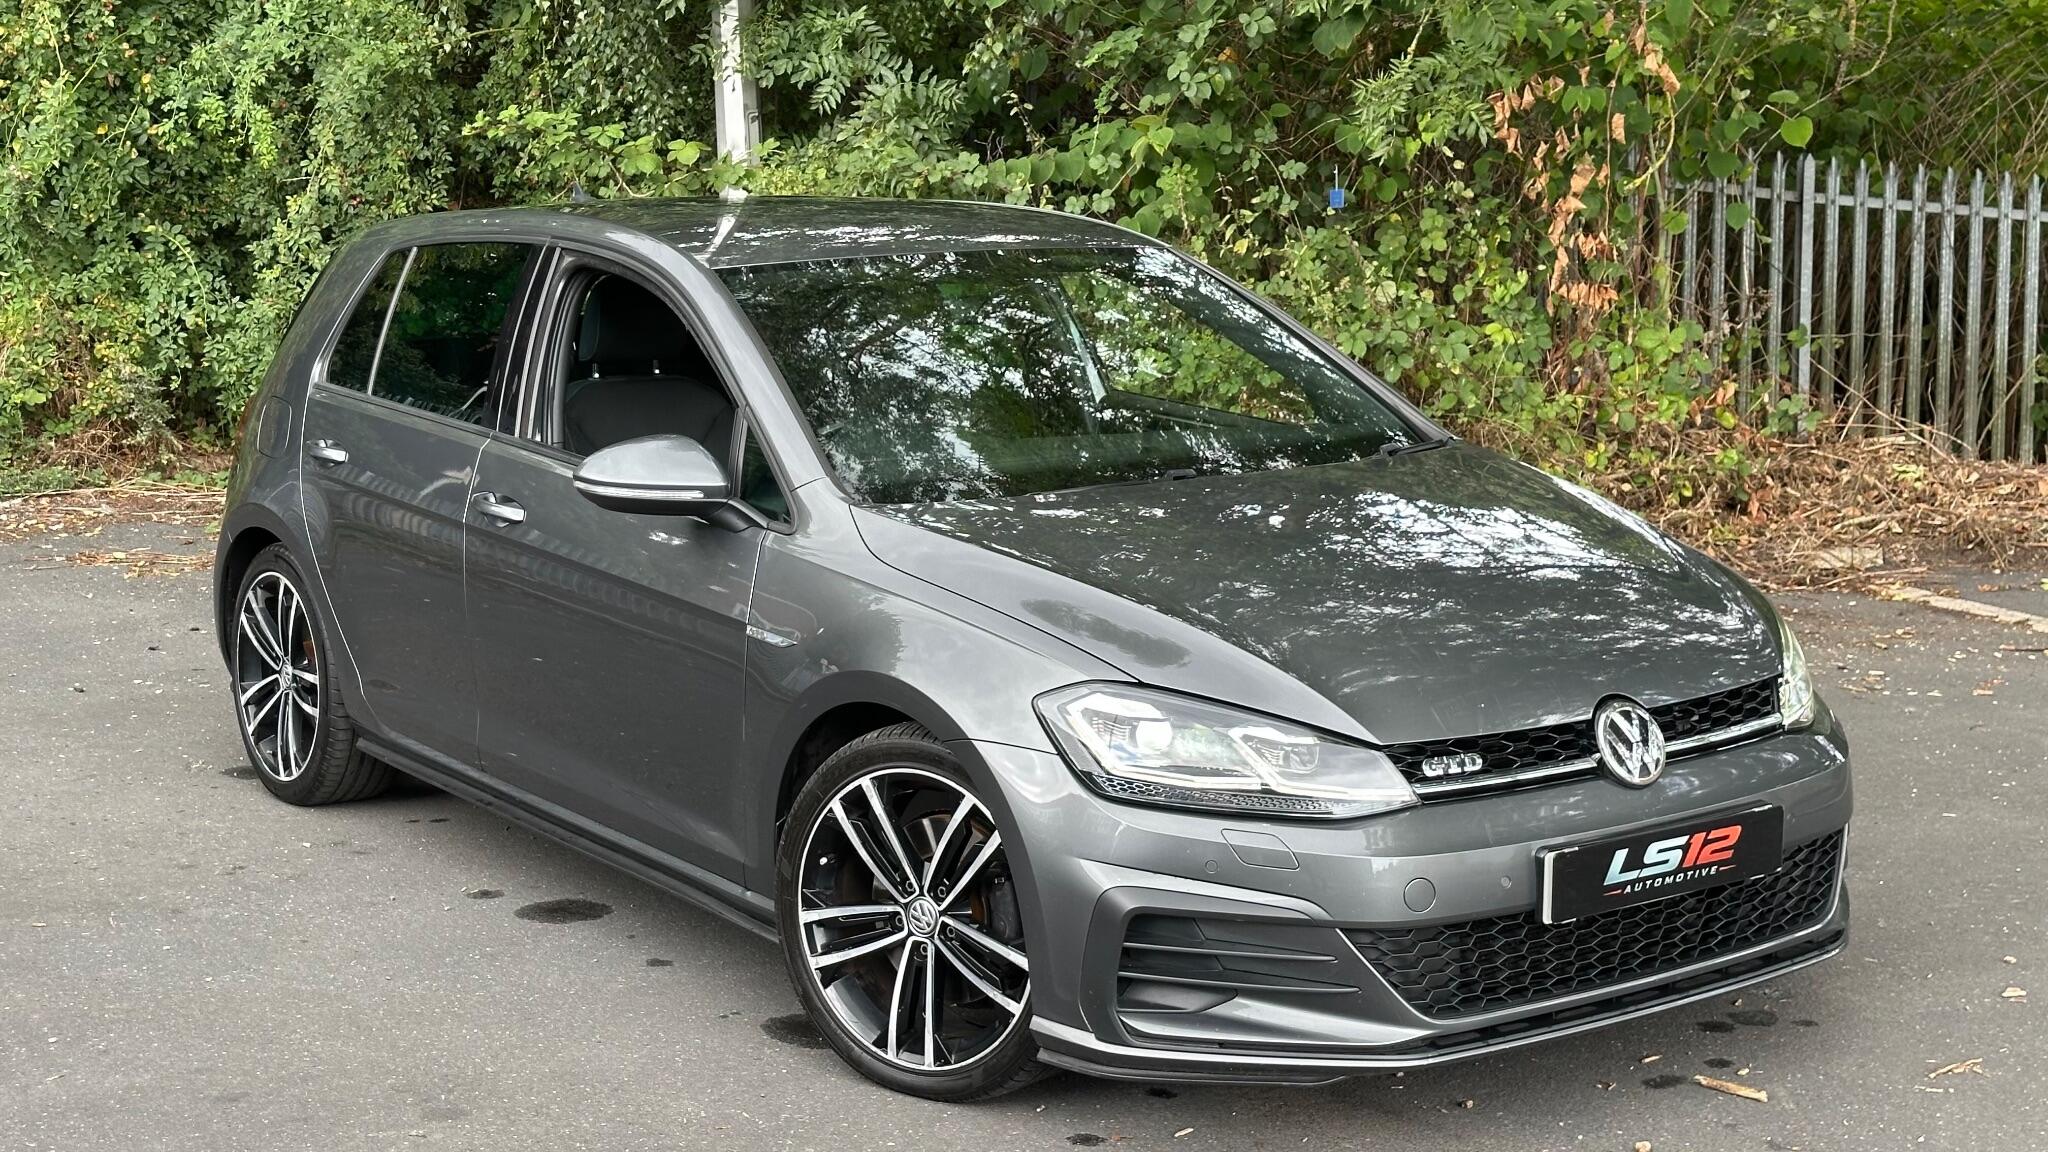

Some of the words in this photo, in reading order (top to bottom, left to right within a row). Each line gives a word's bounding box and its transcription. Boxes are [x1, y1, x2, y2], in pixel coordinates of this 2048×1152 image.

[1422, 753, 1483, 777] GTD
[1602, 825, 1743, 886] LS12
[1623, 865, 1718, 895] AUTOMOTIVE
